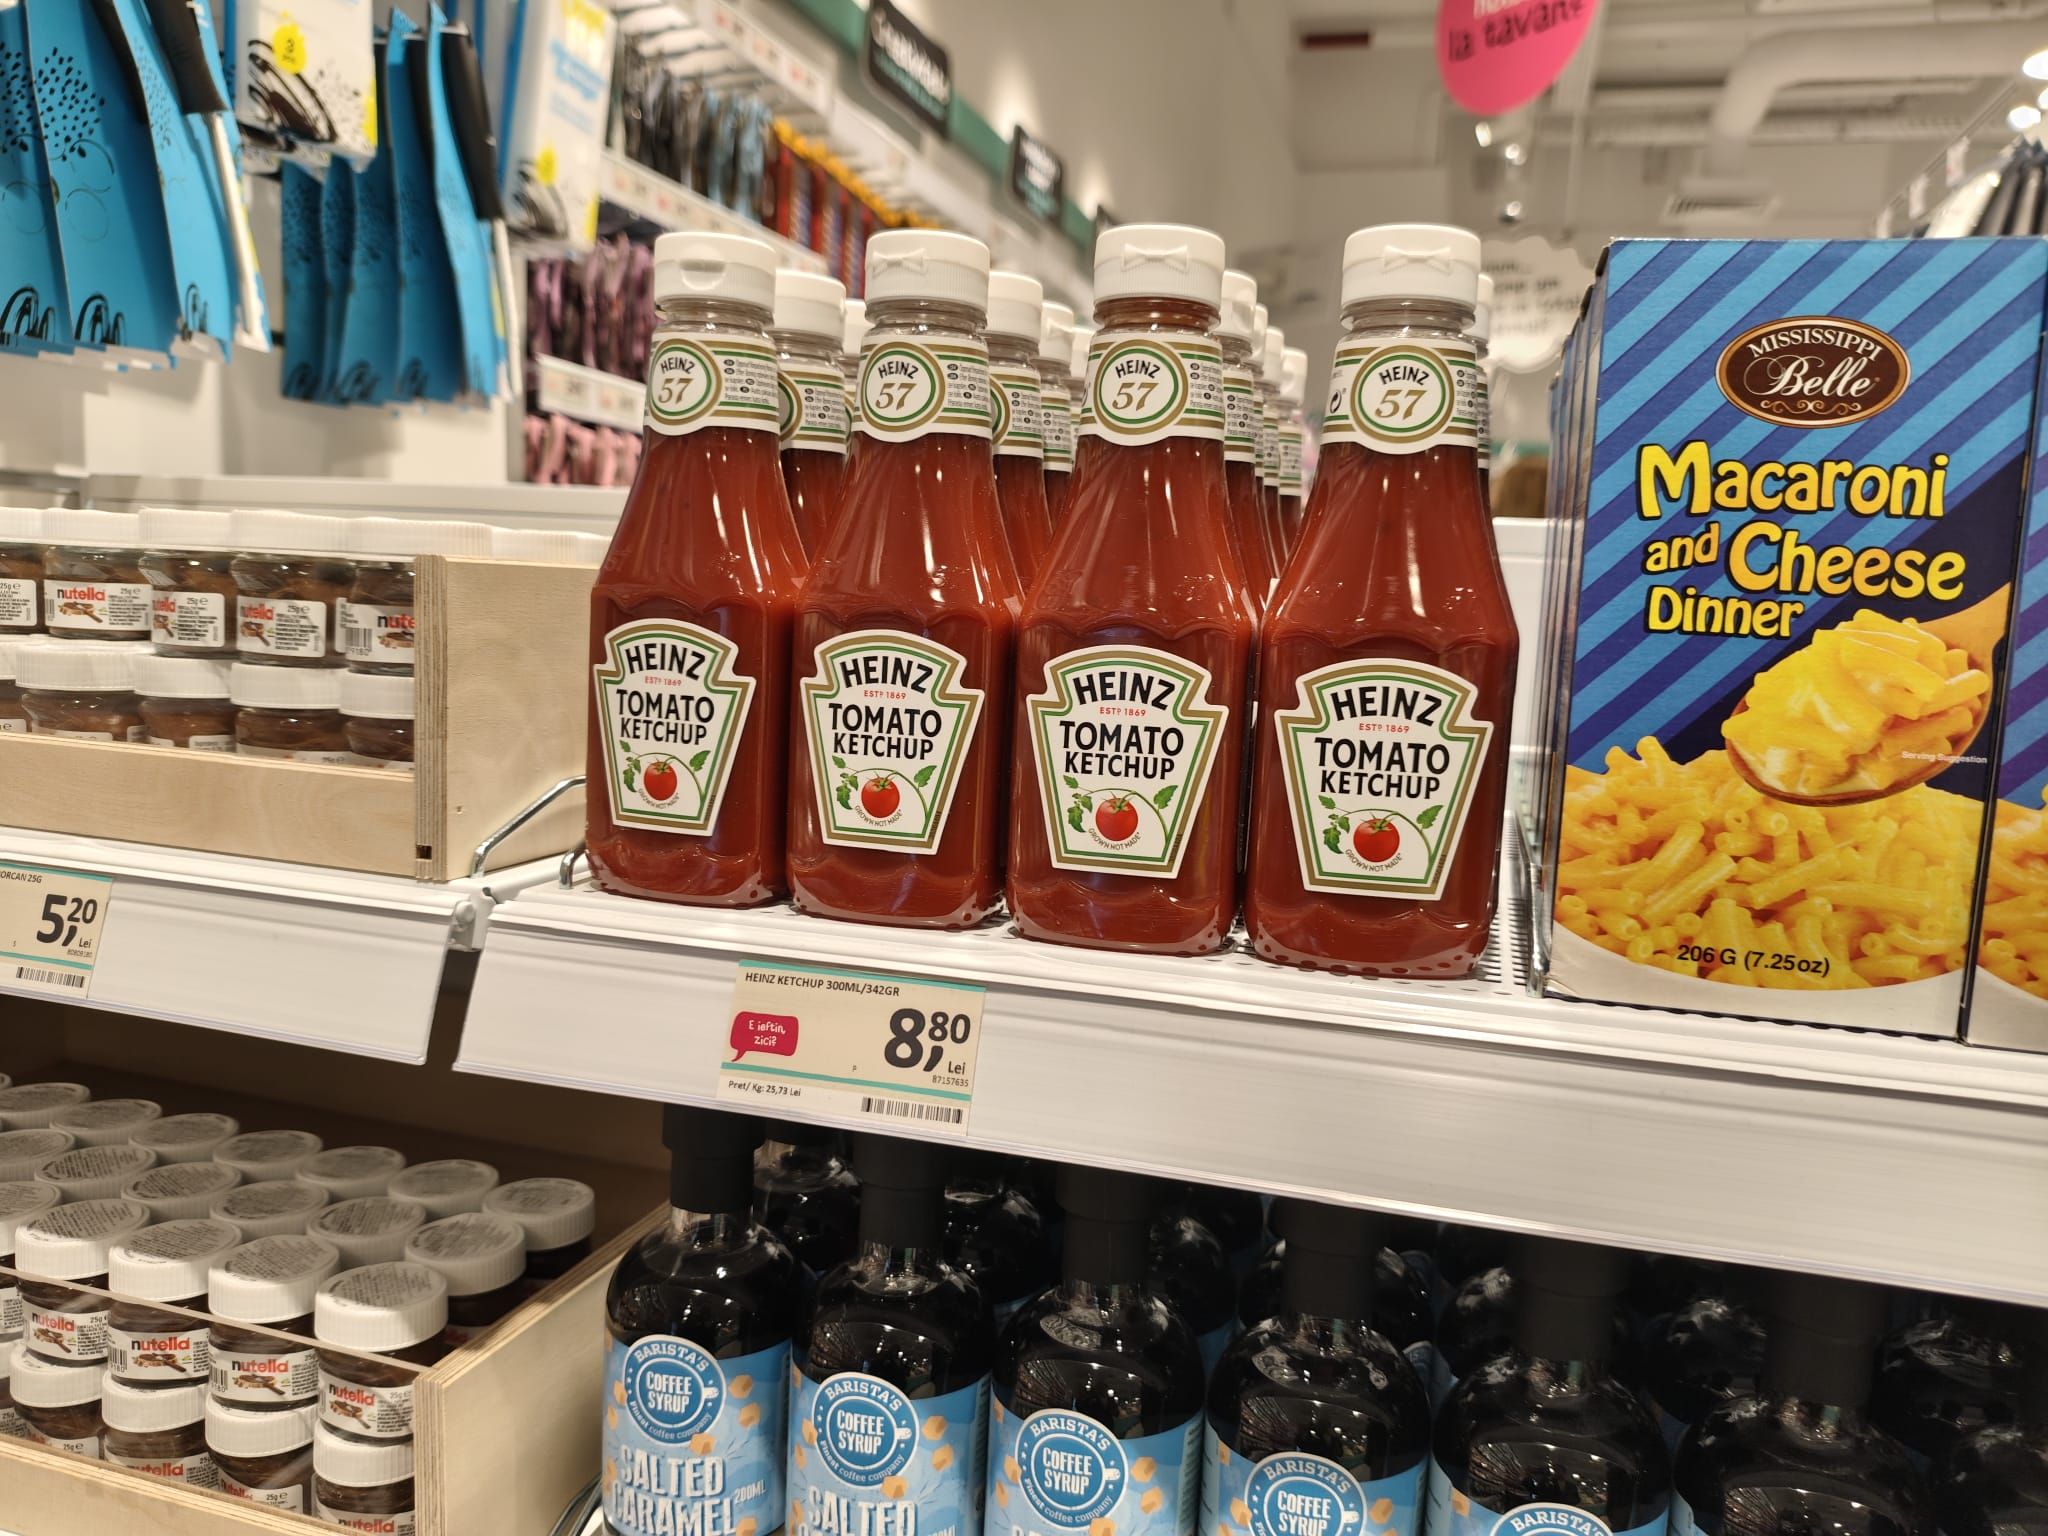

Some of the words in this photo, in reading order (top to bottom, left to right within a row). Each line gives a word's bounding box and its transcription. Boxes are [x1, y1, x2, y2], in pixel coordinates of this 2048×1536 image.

[1747, 327, 1883, 361] MISSISSIPPI
[660, 357, 695, 374] HEINZ
[878, 360, 918, 379] HEINZ
[1115, 360, 1160, 379] HEINZ
[1379, 366, 1430, 386] HEINZ
[1743, 354, 1877, 397] Belle
[658, 378, 693, 404] 57
[876, 382, 917, 411] 57
[1112, 382, 1159, 411] 57
[1375, 389, 1427, 420] 57
[1639, 441, 1950, 518] Macaroni
[1645, 521, 1720, 572] and
[1729, 521, 1966, 600] Cheese
[57, 587, 106, 601] nutella
[152, 597, 177, 613] utella
[377, 613, 415, 629] nute
[1648, 586, 1805, 637] Dinner
[625, 643, 706, 681] HEINZ
[839, 655, 933, 694] HEINZ
[885, 691, 907, 700] 1869
[1072, 671, 1176, 711] HEINZ
[616, 689, 715, 724] TOMATO
[1124, 708, 1146, 717] 1869
[1330, 686, 1443, 727] HEINZ
[620, 717, 707, 745] KETCHUP
[828, 703, 942, 738] TOMATO
[1386, 724, 1410, 734] 1869
[833, 733, 934, 761] KETCHUP
[1059, 720, 1184, 757] TOMATO
[1064, 751, 1175, 780] KETCHUP
[1314, 737, 1450, 775] TOMATO
[1901, 751, 1936, 762] Serving
[1937, 753, 1988, 764] Suggestion
[1320, 770, 1441, 800] KETCHUP
[854, 804, 874, 826] GROWN
[1087, 828, 1110, 849] GROWN
[1110, 842, 1124, 851] NOT
[1345, 849, 1368, 871] GROWN
[1369, 864, 1384, 873] NOT
[0, 871, 27, 882] ORCAN
[27, 874, 43, 883] 25G
[79, 937, 92, 948] Lei
[1677, 944, 1715, 963] 206
[1719, 948, 1737, 966] G
[745, 972, 776, 985] HEINZ
[778, 975, 824, 989] KETCHUP
[826, 980, 900, 997] 300ML/342GR
[749, 1019, 755, 1030] E
[753, 1035, 777, 1047] zici?
[932, 1074, 969, 1088] 87157635
[948, 1061, 966, 1076] Lei
[728, 1079, 751, 1091] Pret/
[752, 1083, 765, 1094] Kg:
[766, 1084, 788, 1096] 25,73
[790, 1087, 801, 1097] Lei
[32, 1312, 75, 1331] nutella
[131, 1336, 190, 1351] nutella
[231, 1359, 289, 1373] nutella
[634, 1343, 710, 1372] BARISTA'S
[329, 1384, 375, 1406] nutella
[645, 1371, 693, 1396] COFFEE
[825, 1381, 902, 1412] BARISTA'S
[648, 1391, 690, 1414] SYRUP
[630, 1400, 649, 1428] Finest
[649, 1426, 675, 1440] coffee
[836, 1409, 885, 1436] COFFEE
[838, 1432, 882, 1455] SYRUP
[1030, 1417, 1111, 1451] BARISTA'S
[621, 1445, 725, 1497] SALTED
[820, 1440, 839, 1470] Finest
[839, 1467, 867, 1482] coffee
[868, 1454, 905, 1481] company
[1042, 1447, 1093, 1476] COFFEE
[1044, 1469, 1090, 1496] SYRUP
[1263, 1460, 1351, 1494] BARISTA'S
[266, 1493, 279, 1501] 25g
[734, 1480, 766, 1505] 200ML
[1024, 1478, 1045, 1509] Finest
[1044, 1506, 1073, 1523] coffee
[1075, 1495, 1113, 1522] company
[1277, 1490, 1332, 1519] COFFEE
[612, 1479, 737, 1536] CARAMEL
[808, 1485, 916, 1536] SALTED
[1278, 1513, 1328, 1536] SYRUP
